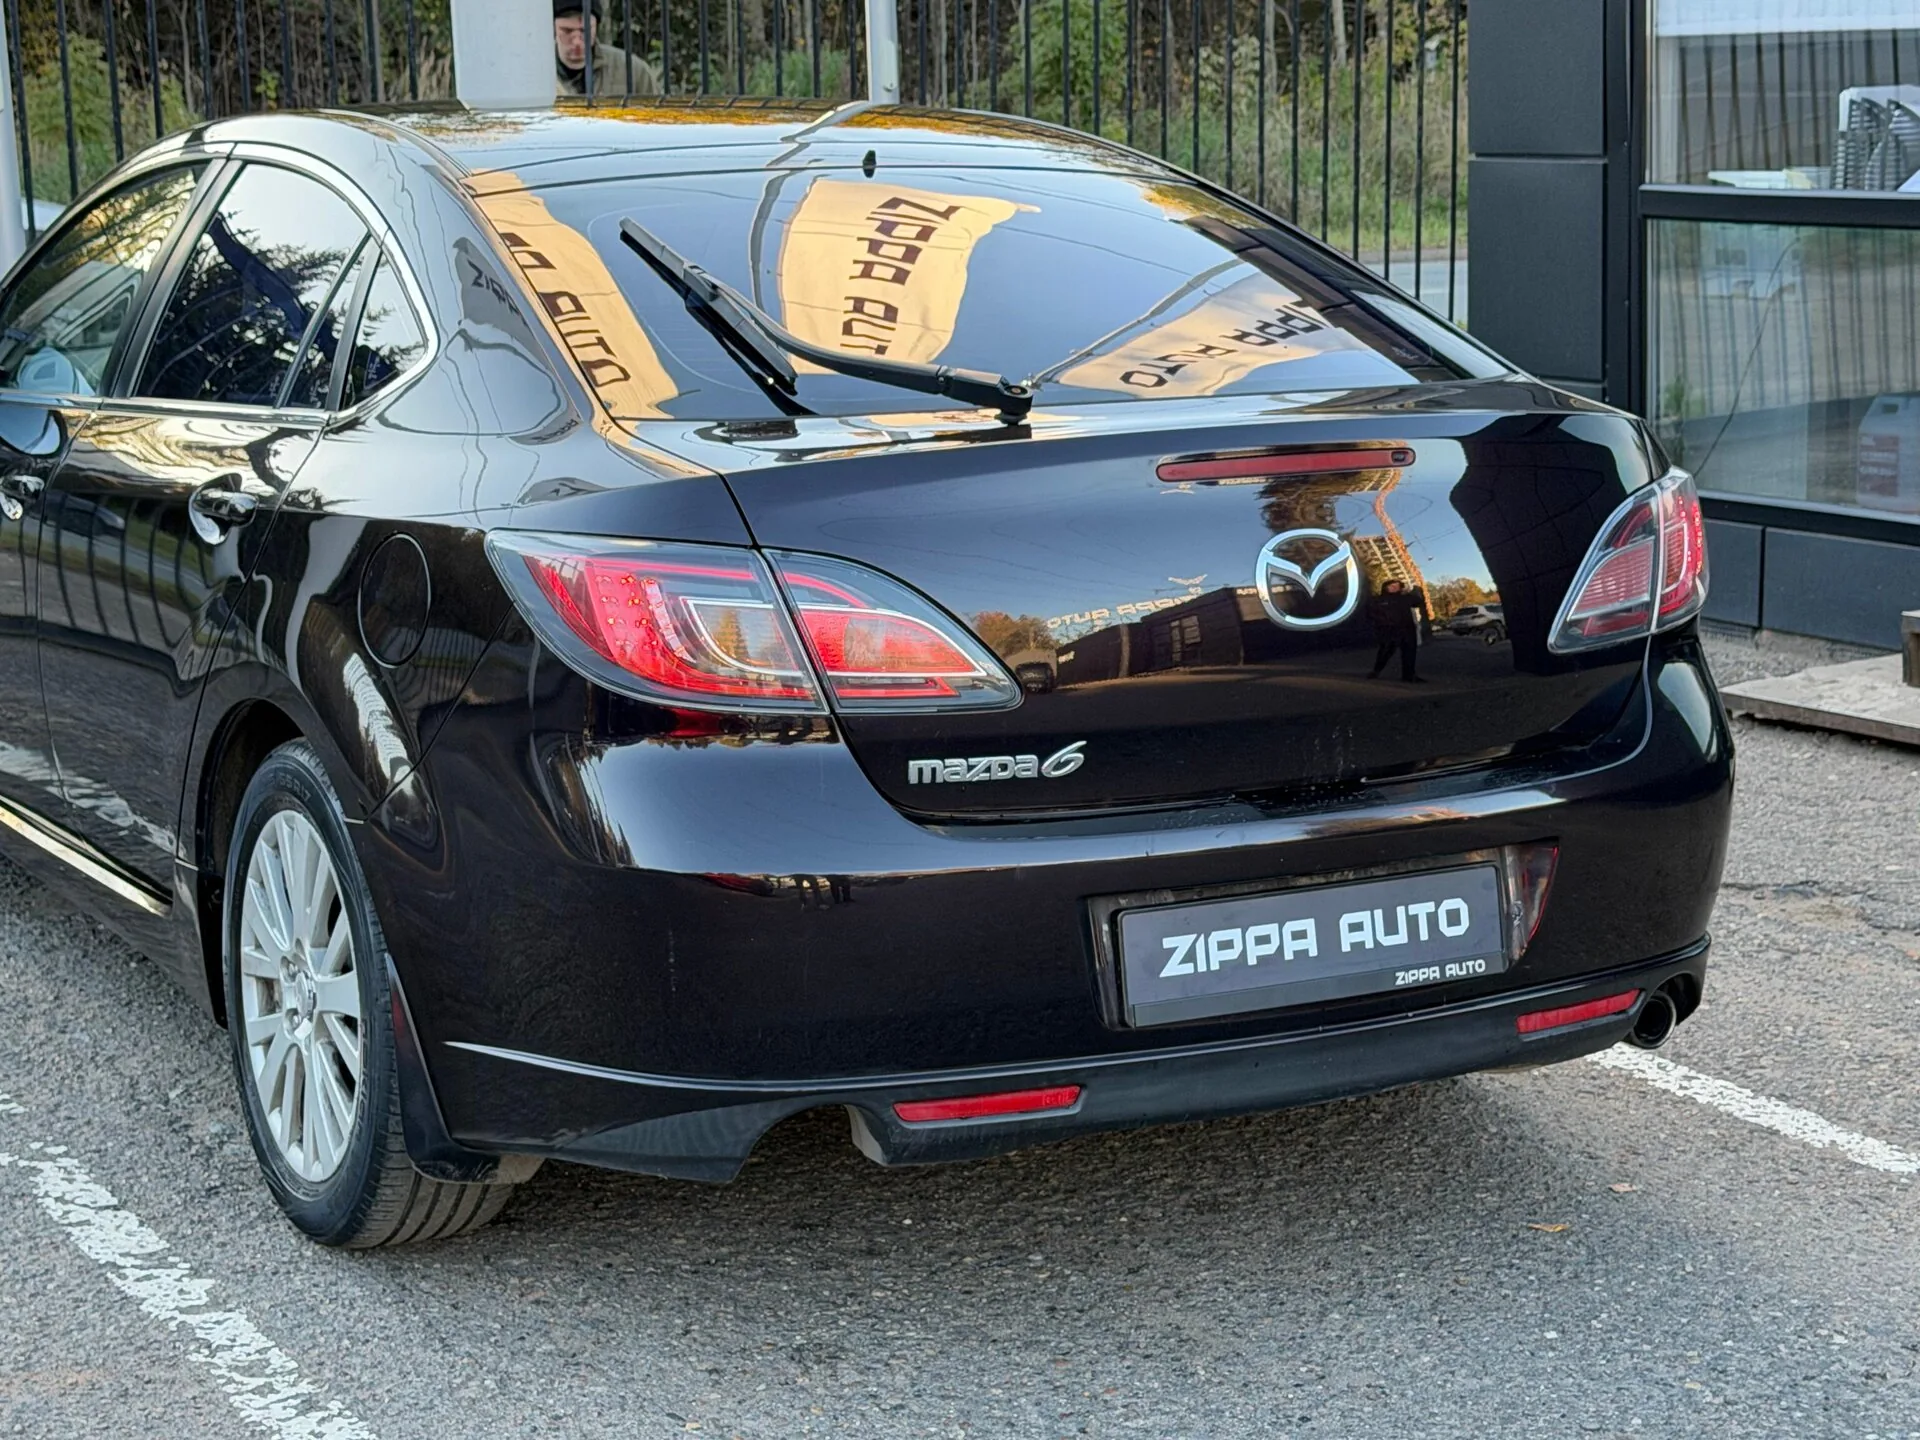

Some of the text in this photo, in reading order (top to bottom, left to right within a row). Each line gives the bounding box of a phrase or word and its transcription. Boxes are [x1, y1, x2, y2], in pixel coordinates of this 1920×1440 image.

[849, 196, 961, 286] ZIPPA
[1219, 304, 1330, 347] IPPA
[1159, 897, 1470, 978] ZIPPA AUTO
[1395, 959, 1486, 986] ZIPPA AUTO
